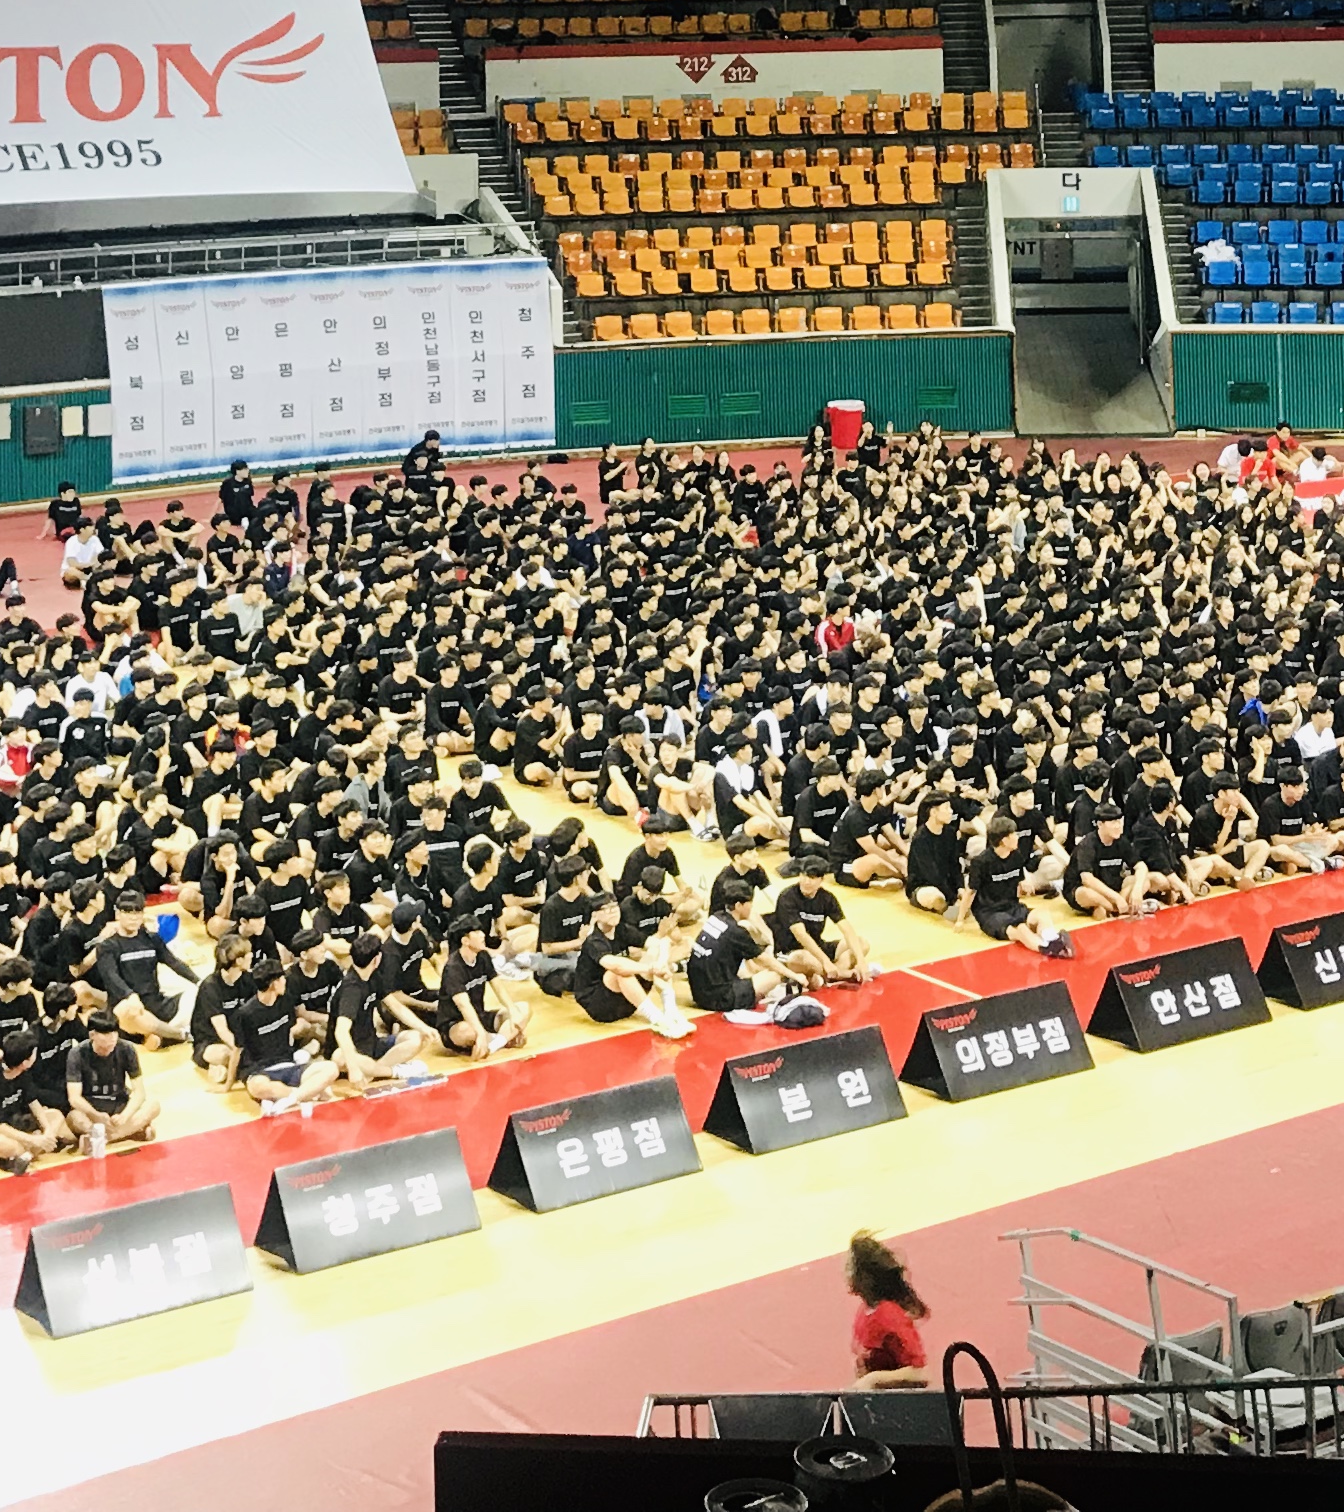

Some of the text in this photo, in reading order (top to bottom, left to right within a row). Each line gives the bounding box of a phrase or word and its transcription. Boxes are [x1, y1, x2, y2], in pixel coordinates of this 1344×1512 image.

[683, 56, 709, 73] 212
[727, 66, 752, 82] 312
[1062, 172, 1082, 191] 다
[124, 334, 145, 432] 성북점
[174, 329, 196, 427] 신림점
[224, 325, 246, 420] 안양점
[273, 322, 295, 419] 은평점
[322, 318, 344, 413] 안산점
[372, 314, 393, 408] 의정부점
[468, 309, 487, 404] 인천서구점
[517, 306, 537, 399] 청주점
[955, 1016, 1071, 1074] 의정부점
[1150, 973, 1242, 1027] 안산점
[556, 1117, 667, 1179] 은평점
[321, 1172, 443, 1237] 청주점
